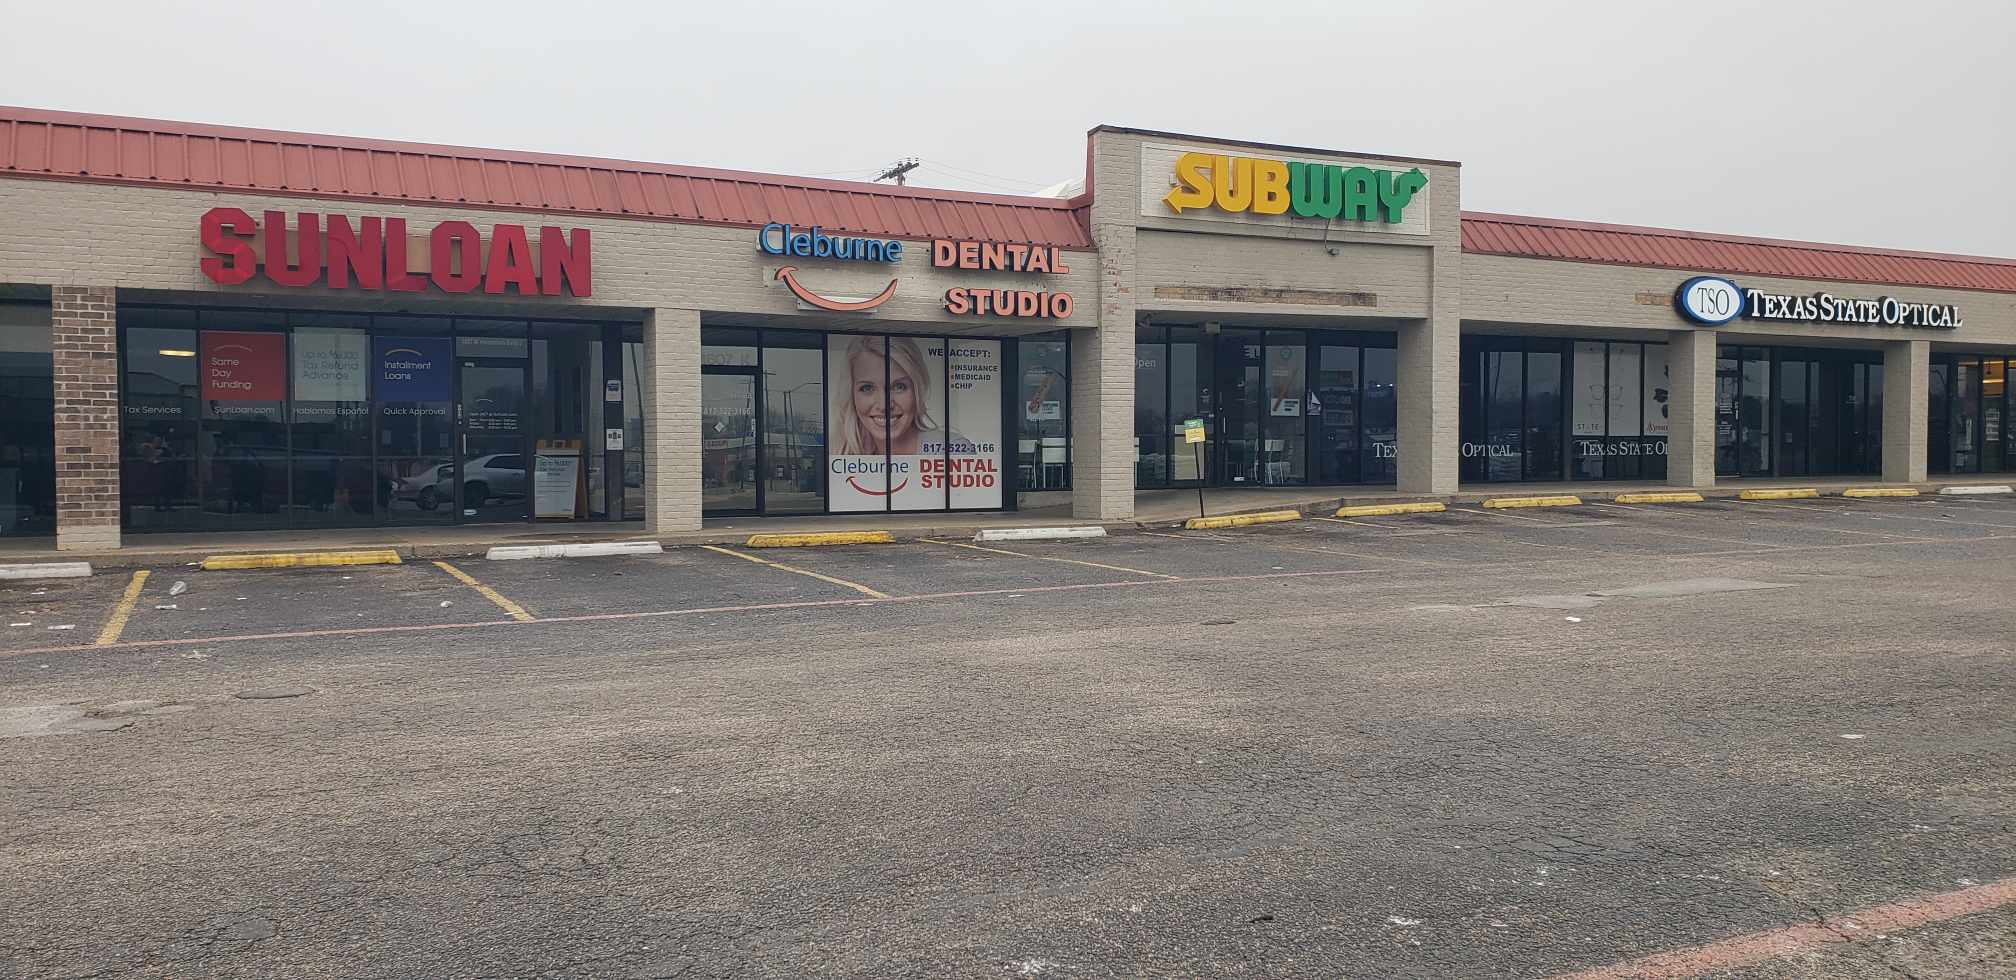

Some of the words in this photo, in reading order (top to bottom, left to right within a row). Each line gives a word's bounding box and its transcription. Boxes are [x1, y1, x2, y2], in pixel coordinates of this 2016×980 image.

[1161, 152, 1430, 225] SUBWAY
[758, 223, 904, 263] Cleburne
[200, 207, 592, 297] SUNLOAN
[931, 239, 1070, 274] DENTAL
[943, 287, 1075, 319] STUDIO
[1697, 287, 1730, 316] TSO
[1747, 289, 1816, 321] TEXAS
[1820, 293, 1881, 324] STATE
[1882, 297, 1963, 329] OPTICAL
[928, 348, 944, 358] WE
[950, 349, 991, 359] ACCEPT:
[211, 357, 240, 366] Same
[211, 369, 232, 379] Day
[384, 372, 411, 380] Loans
[212, 380, 252, 391] Funding
[124, 406, 140, 414] Tax
[142, 406, 182, 414] Services
[337, 406, 369, 417] Español
[383, 408, 407, 416] Quick
[409, 408, 446, 417] Approval
[1462, 442, 1513, 458] OPTICAL
[831, 458, 909, 474] Cleburne
[919, 459, 998, 473] DENTAL
[921, 474, 995, 489] STUDIO
